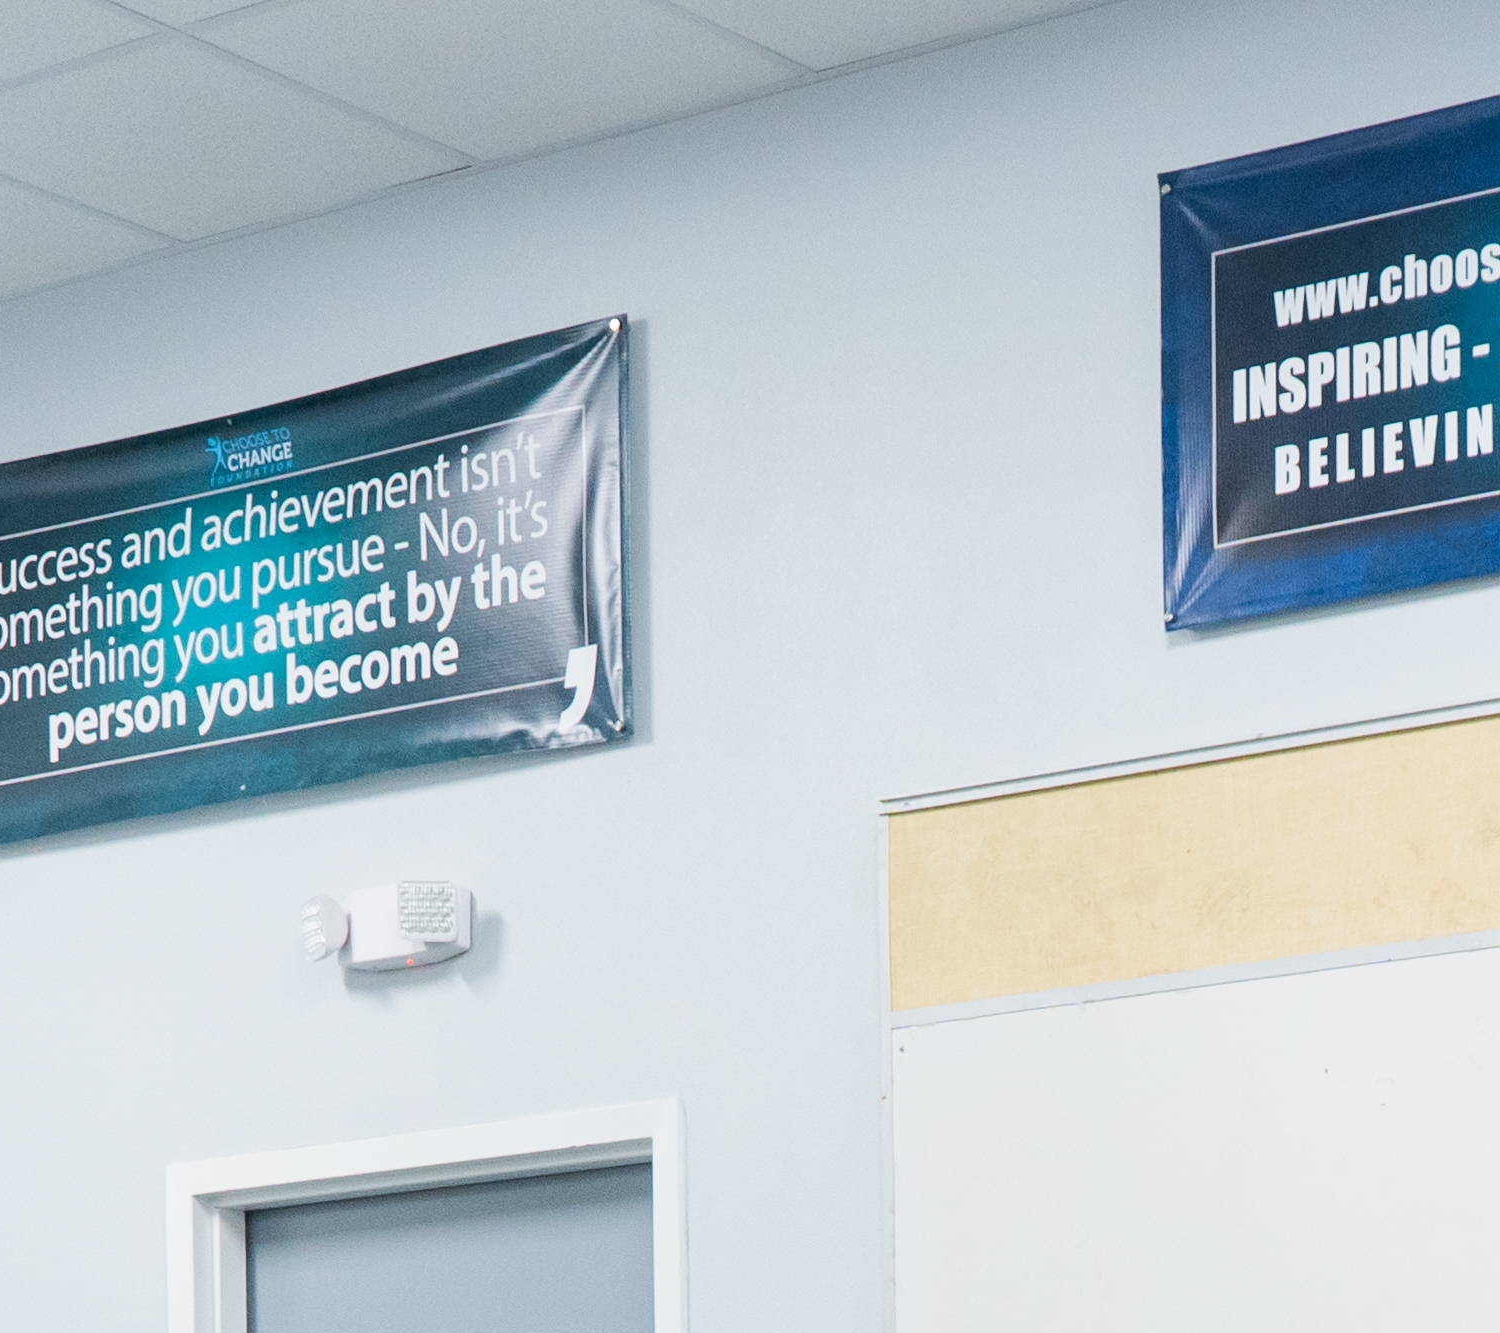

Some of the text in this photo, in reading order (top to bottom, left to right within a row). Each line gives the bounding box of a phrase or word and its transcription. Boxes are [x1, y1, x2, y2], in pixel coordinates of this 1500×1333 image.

[1233, 324, 1461, 424] INSPIRING
[210, 460, 293, 487] FOUNDATION
[222, 427, 290, 454] CHOOSE TO
[227, 441, 293, 472] CHANGE
[121, 507, 192, 569] and
[201, 454, 451, 551] achievement
[172, 566, 241, 627] you
[252, 535, 385, 609] pursue
[419, 508, 487, 561] No,
[173, 622, 244, 682] you
[253, 582, 396, 654] attract
[407, 570, 462, 633] by
[470, 552, 547, 610] the
[49, 636, 459, 764] person you become
